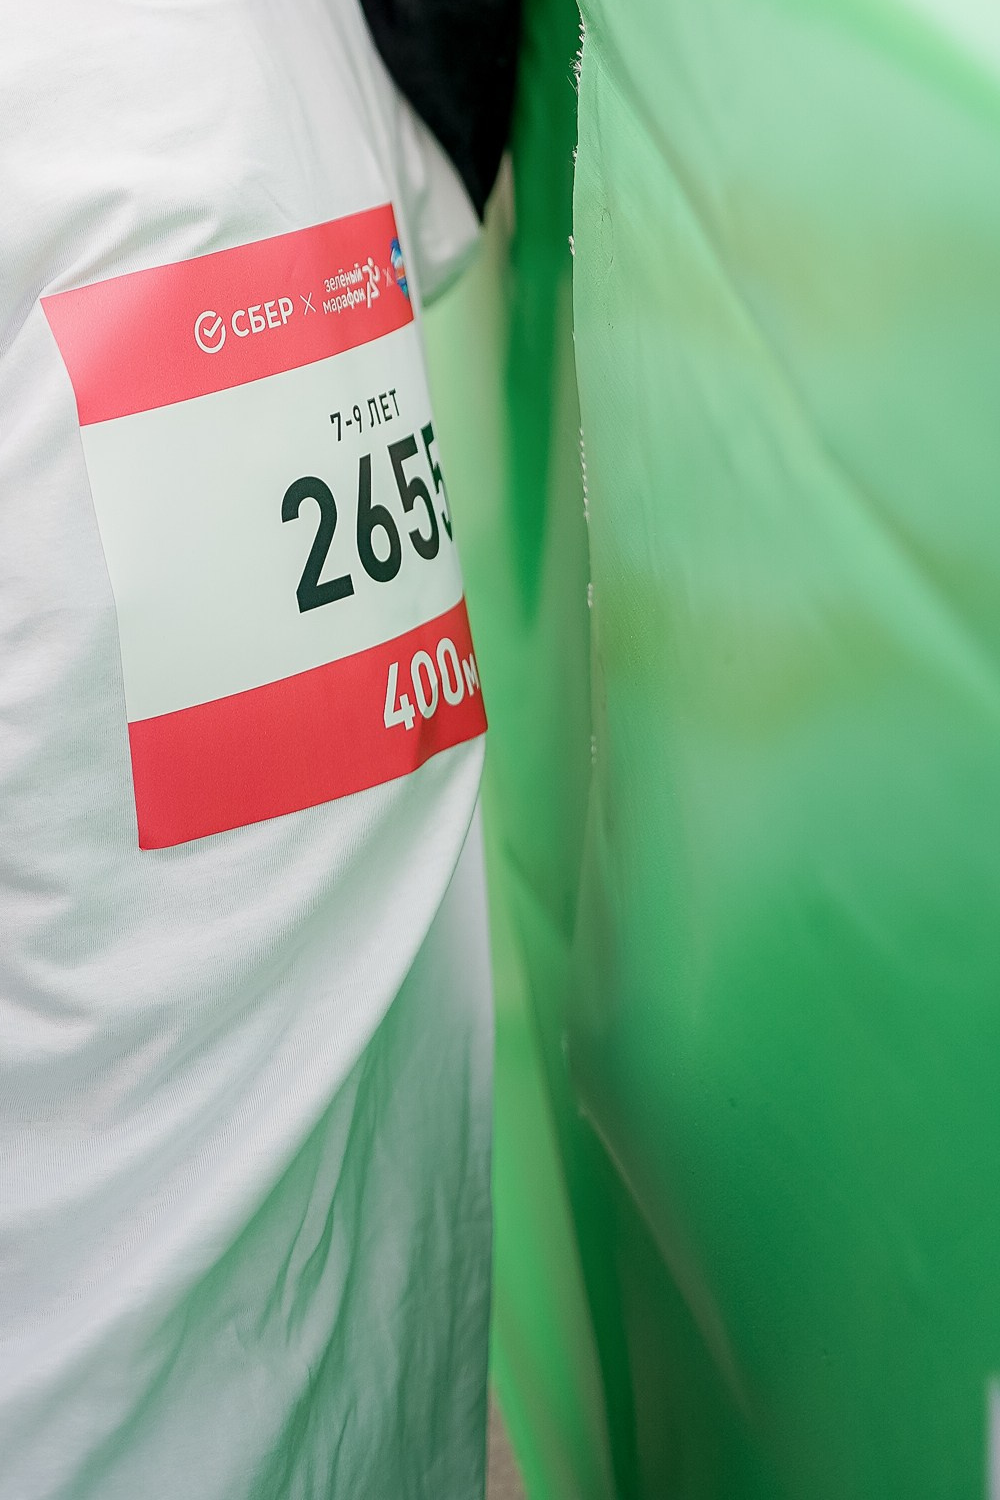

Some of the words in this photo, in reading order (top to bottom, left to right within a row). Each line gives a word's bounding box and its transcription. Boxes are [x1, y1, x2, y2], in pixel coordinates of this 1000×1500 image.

[323, 262, 363, 293] зелёный
[231, 296, 294, 338] СБЕР
[322, 286, 367, 315] марафон
[329, 404, 363, 442] 7-9
[366, 387, 400, 428] ЛЕТ
